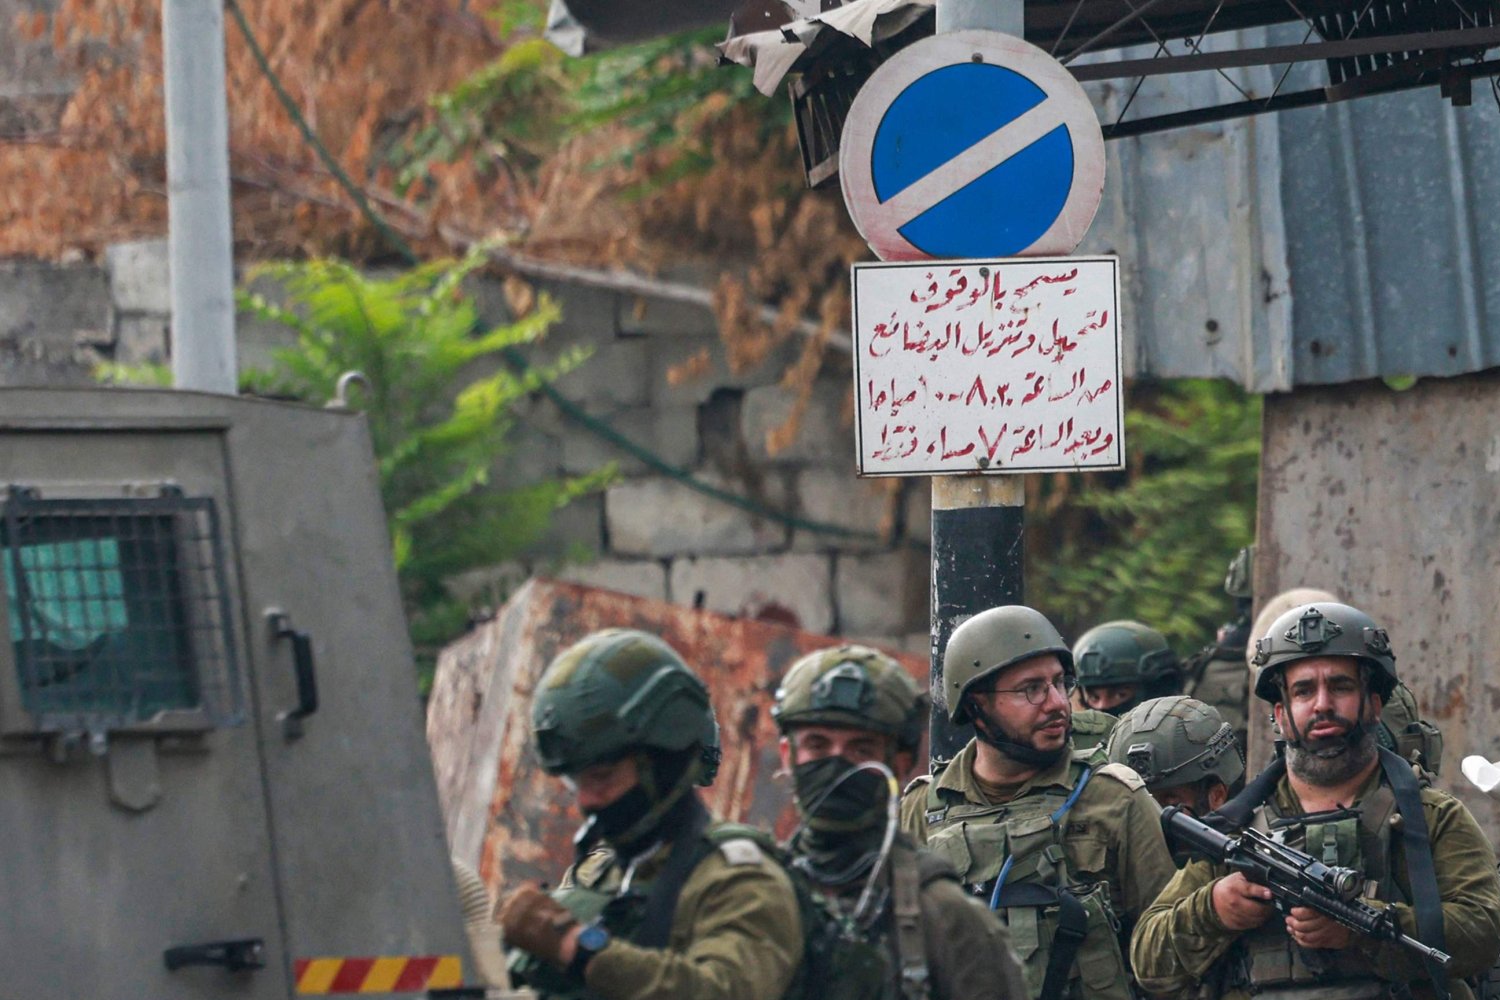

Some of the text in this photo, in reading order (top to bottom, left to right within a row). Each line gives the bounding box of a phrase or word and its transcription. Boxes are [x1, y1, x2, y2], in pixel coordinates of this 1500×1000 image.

[910, 267, 1078, 314] يسمح بالوقوف
[869, 310, 1108, 362] لتحميل وتنزيل البضائع
[868, 378, 917, 416] صباحا
[1021, 367, 1086, 404] الساعة
[1076, 378, 1112, 406] من
[872, 416, 1114, 461] وبعد الساعة ٧ مساء فقط
